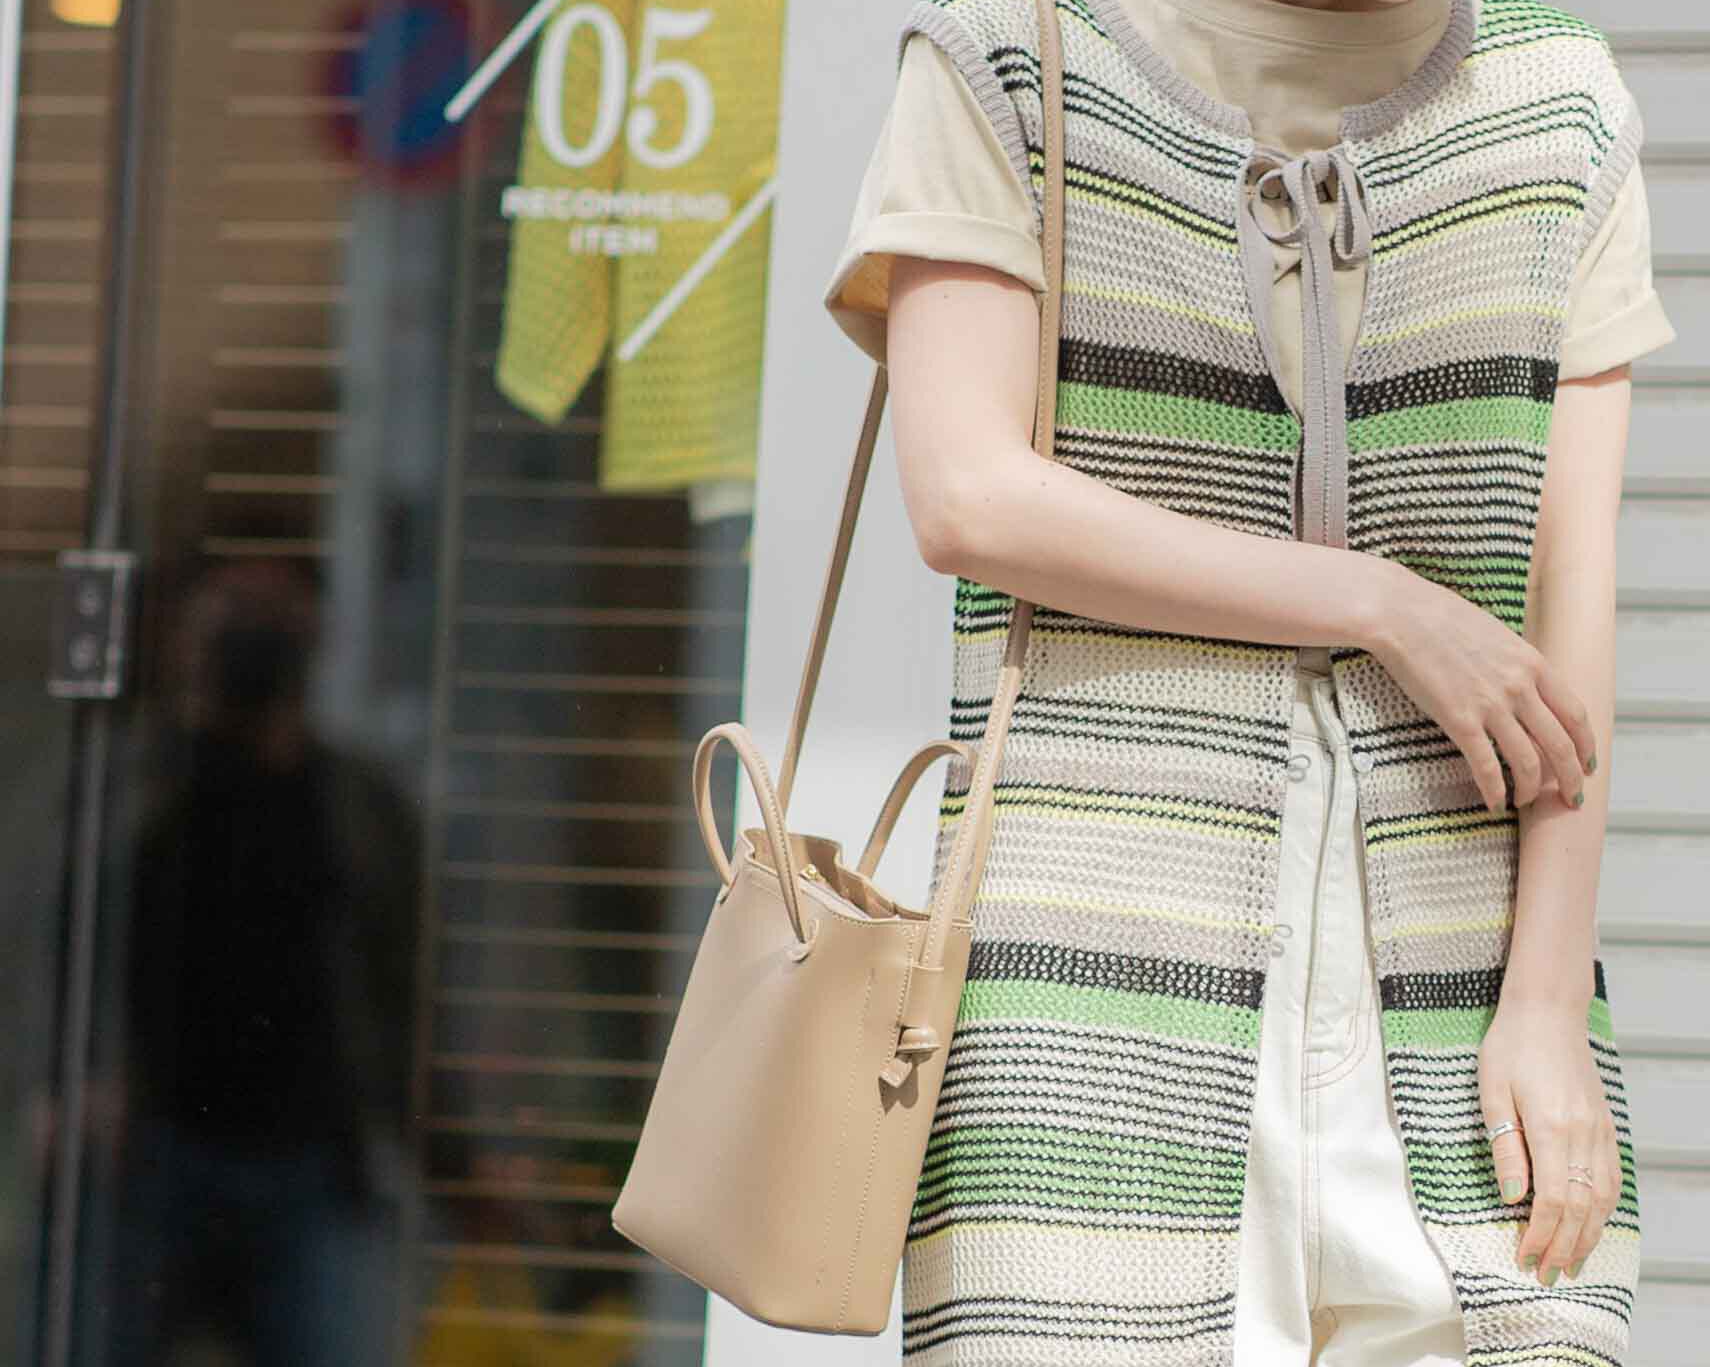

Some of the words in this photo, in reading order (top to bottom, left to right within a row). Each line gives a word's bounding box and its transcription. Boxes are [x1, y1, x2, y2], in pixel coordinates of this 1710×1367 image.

[534, 2, 715, 169] 05
[501, 186, 730, 220] RECOMMEND
[568, 226, 658, 256] ITEM
